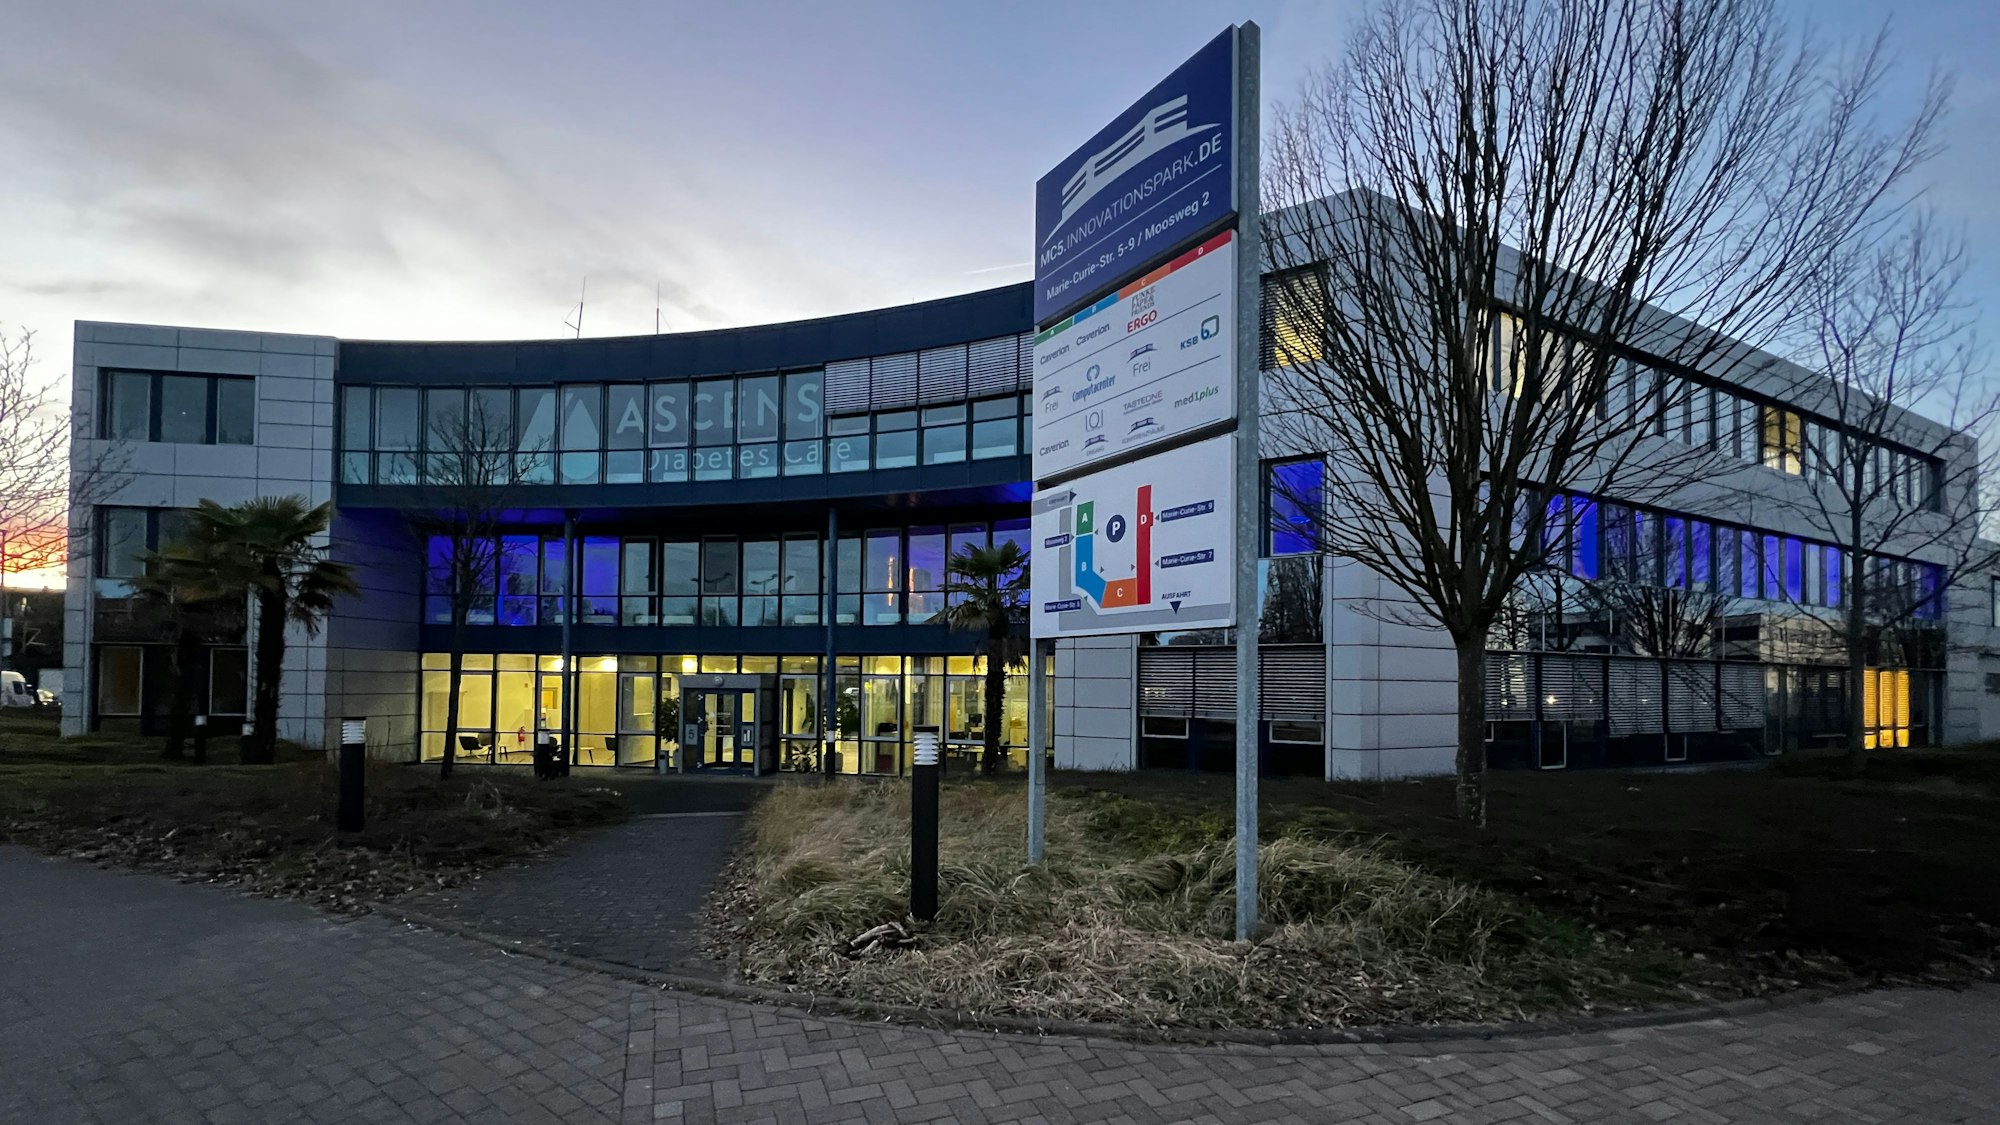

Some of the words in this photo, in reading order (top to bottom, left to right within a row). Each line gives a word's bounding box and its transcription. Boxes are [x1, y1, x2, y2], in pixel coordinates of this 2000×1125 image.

[1040, 133, 1222, 268] MC5.INNOVATIONSPARK.DE
[1046, 250, 1115, 301] Marie-Curie-Str.
[1117, 236, 1135, 257] 5-9
[1145, 202, 1199, 241] Moosweg
[1201, 191, 1210, 207] 2
[1127, 309, 1158, 333] ERGO
[1076, 323, 1110, 346] Caverion
[1180, 335, 1199, 351] KSB
[1040, 343, 1070, 365] Caverion
[1133, 357, 1151, 376] Frei
[1072, 375, 1116, 402] Computacenter
[1174, 385, 1219, 408] med1plus
[1045, 400, 1059, 414] Frei
[1040, 440, 1069, 456] Caverion
[1082, 512, 1088, 524] A
[1140, 515, 1147, 524] D
[1112, 521, 1121, 536] P
[1081, 561, 1087, 572] B
[1117, 587, 1123, 598] C
[1161, 590, 1192, 600] AUSFAHRT
